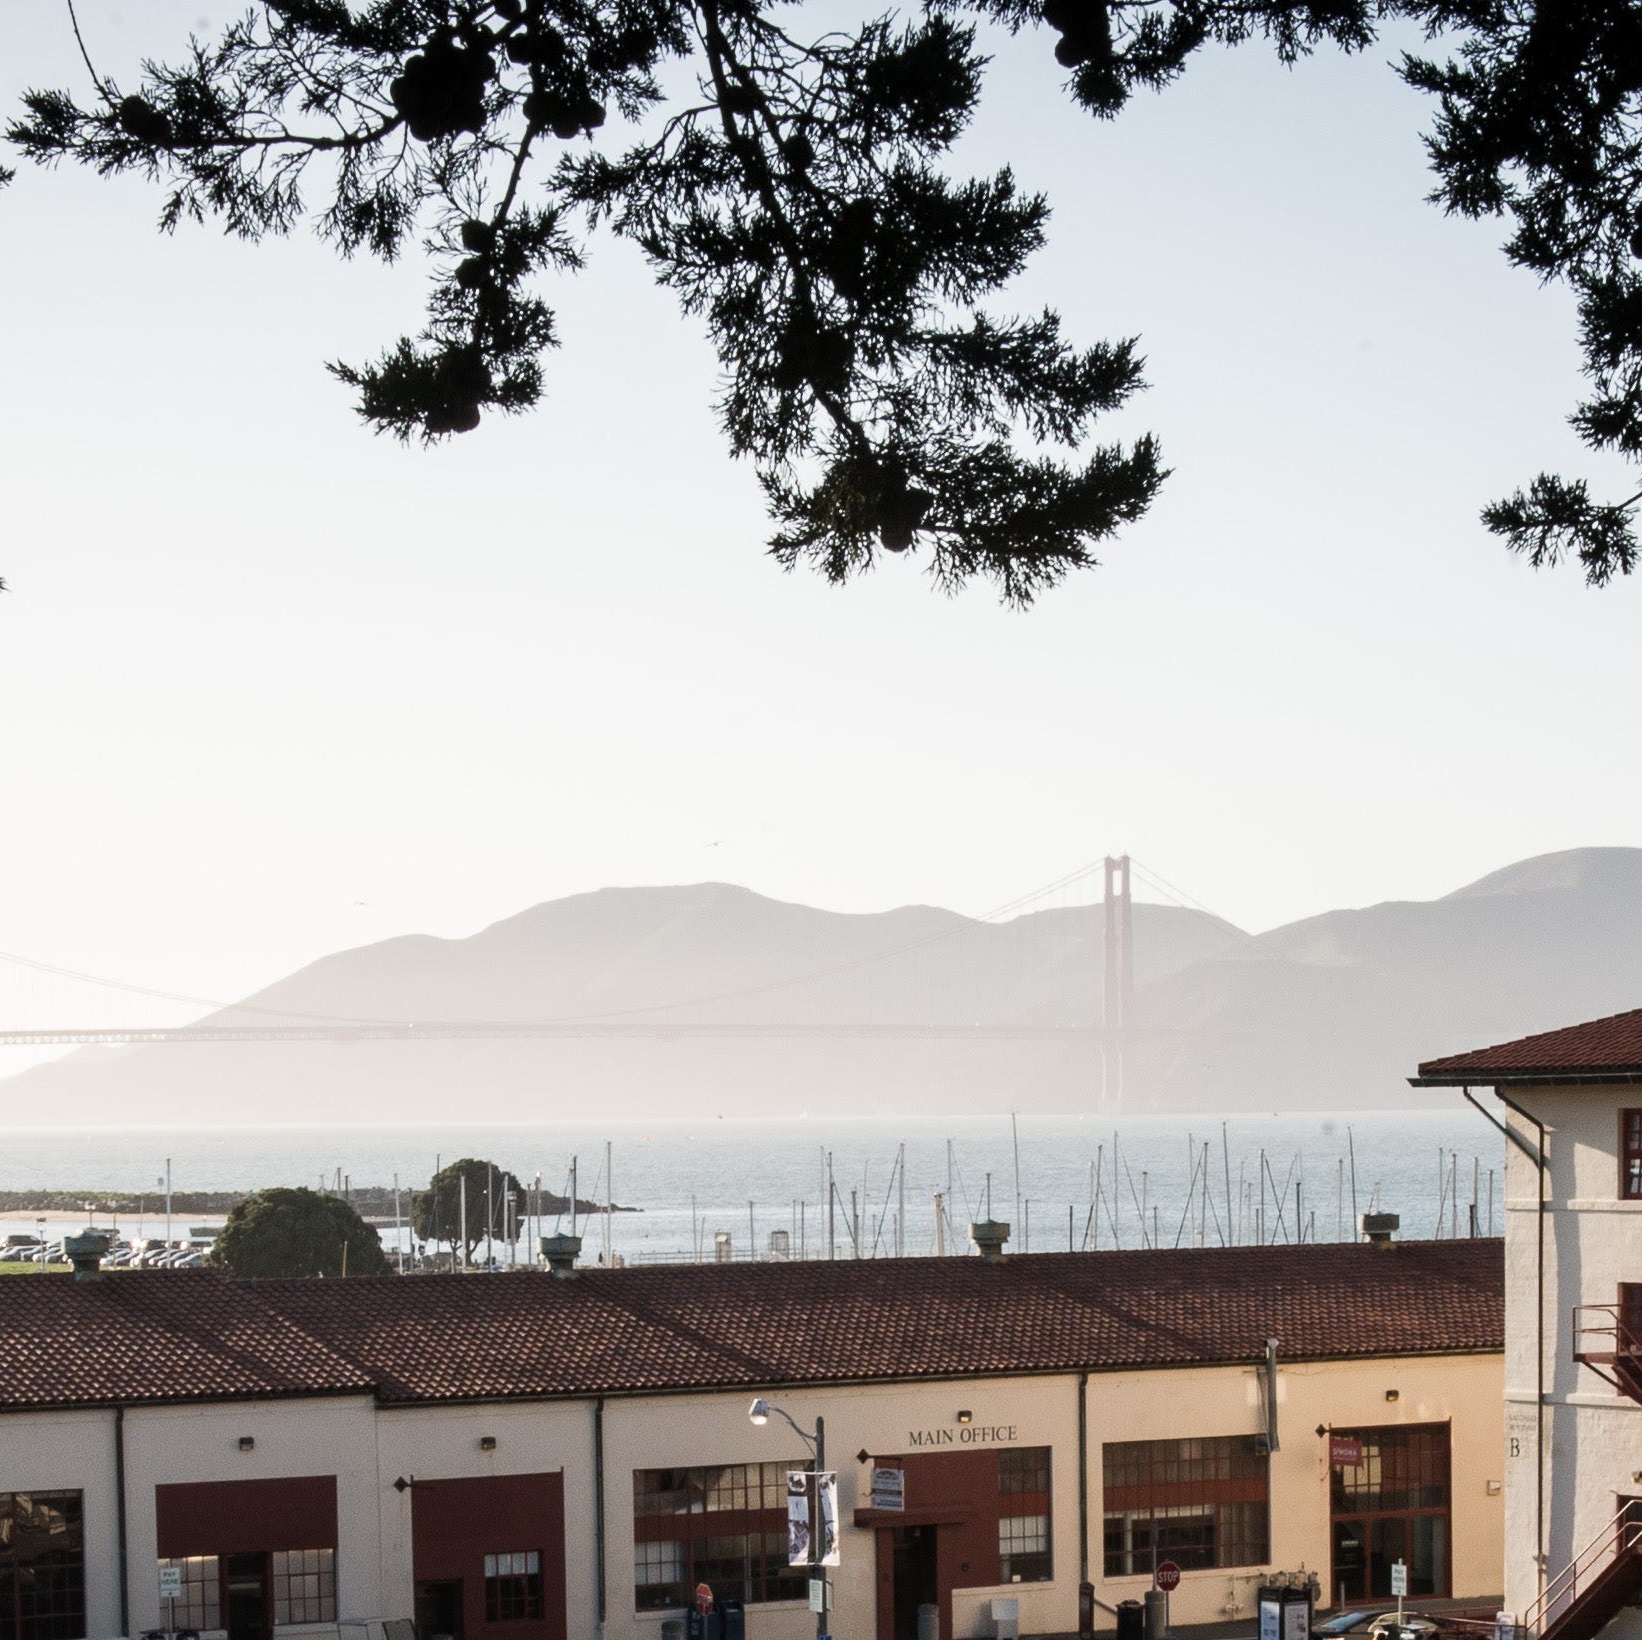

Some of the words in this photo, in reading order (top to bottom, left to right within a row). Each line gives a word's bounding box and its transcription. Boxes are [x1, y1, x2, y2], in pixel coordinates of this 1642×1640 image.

[909, 1429, 954, 1446] MAIN
[960, 1426, 1018, 1443] OFFICE
[1509, 1437, 1520, 1457] B
[1158, 1571, 1179, 1583] STOP
